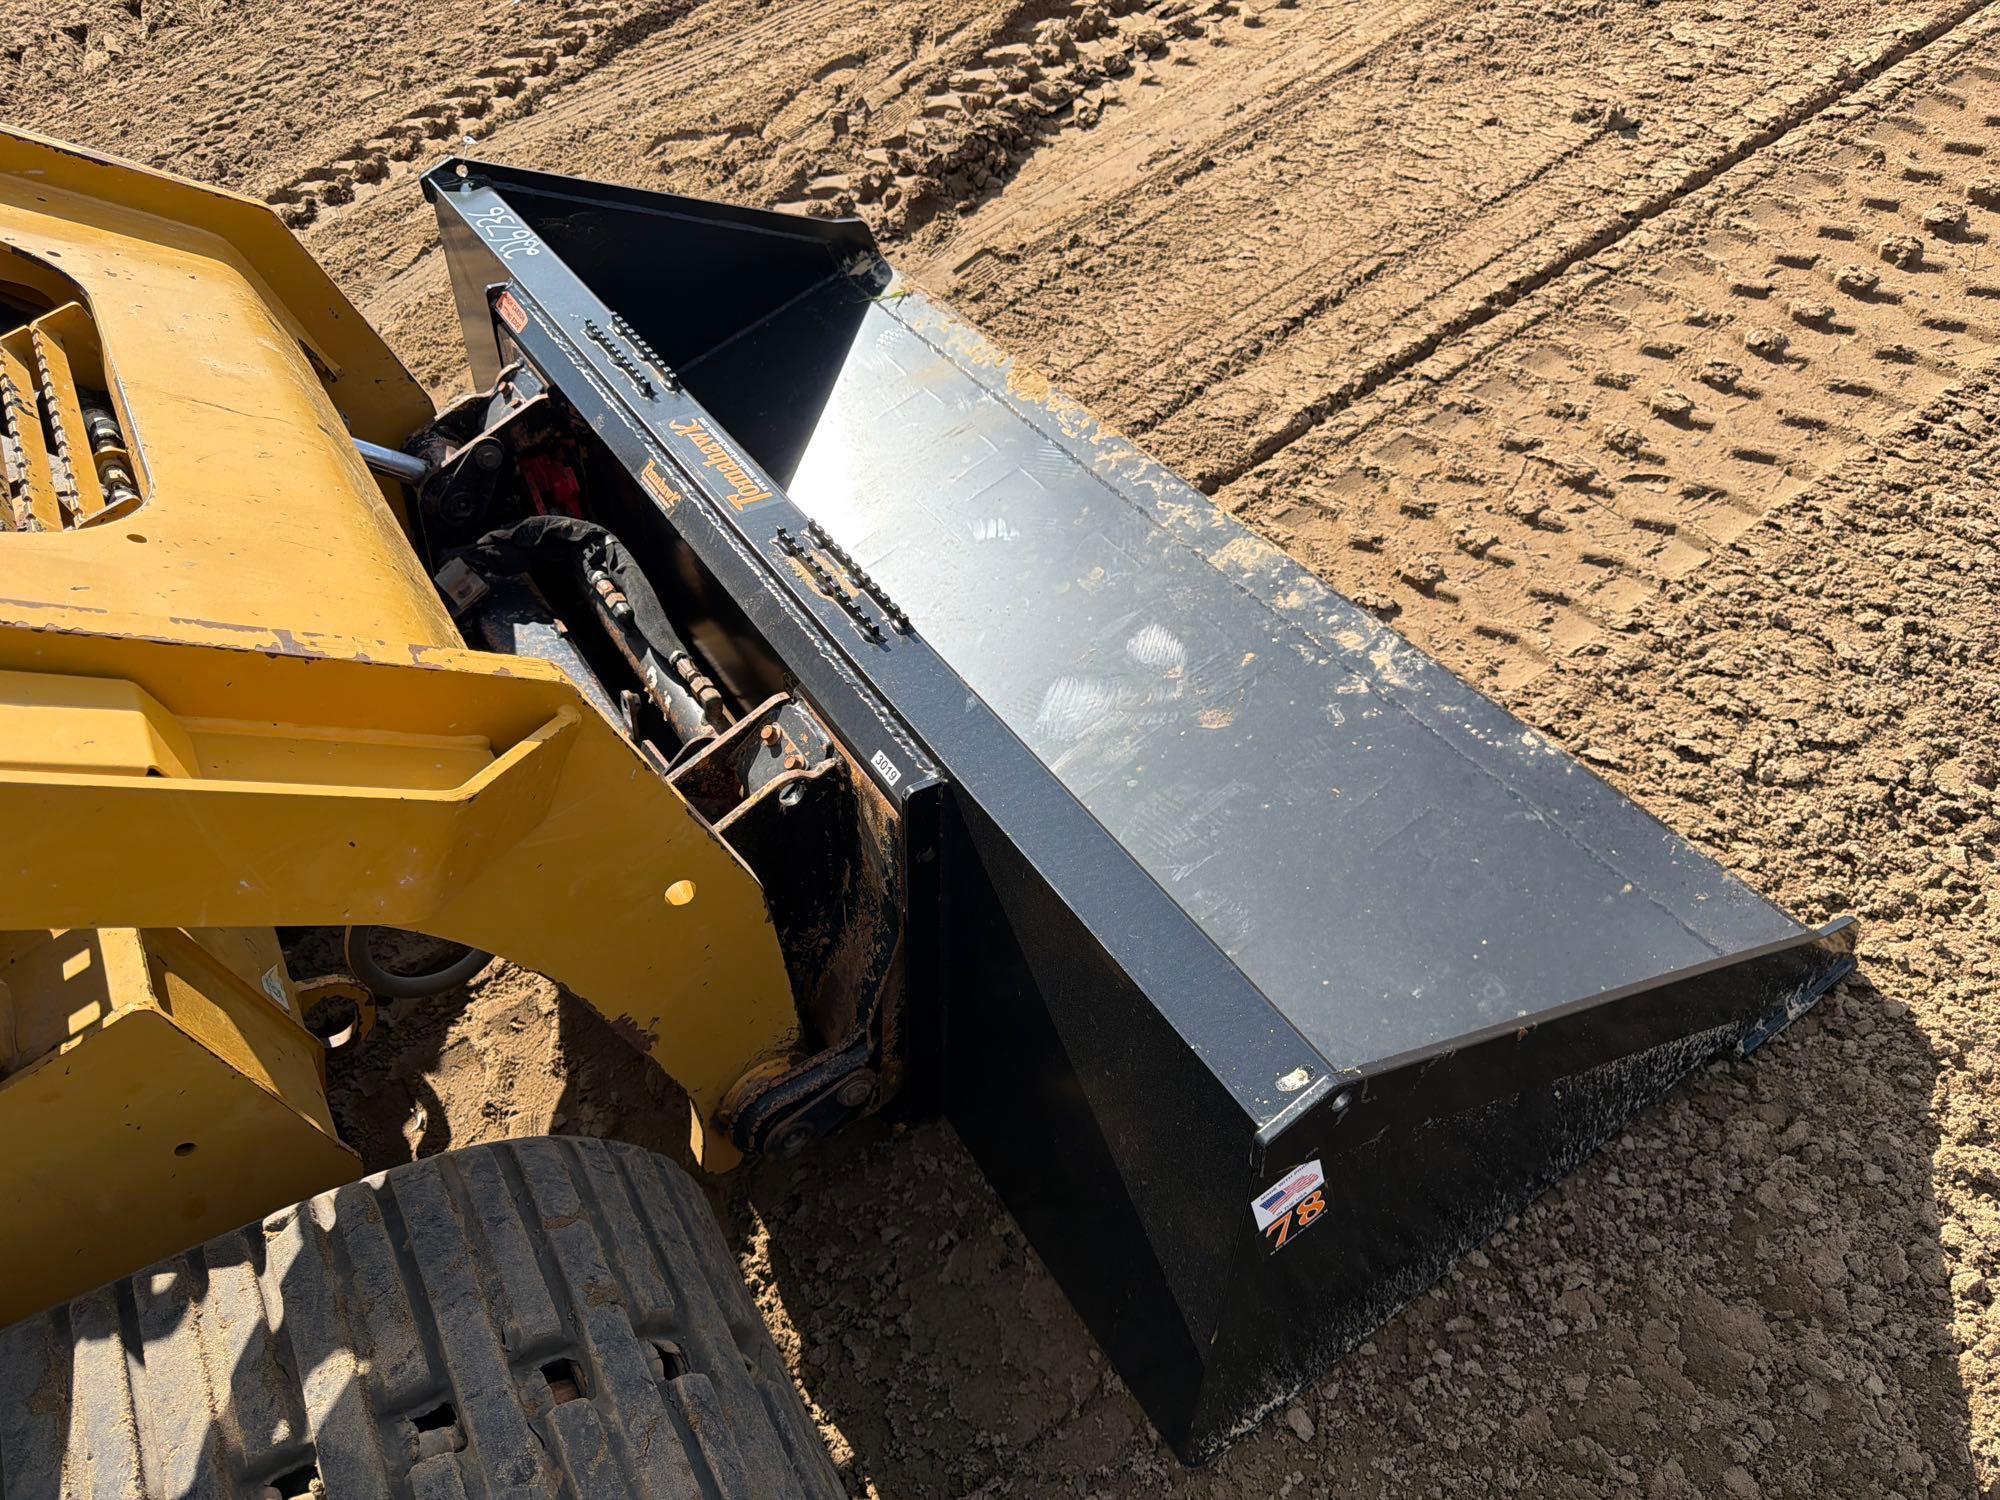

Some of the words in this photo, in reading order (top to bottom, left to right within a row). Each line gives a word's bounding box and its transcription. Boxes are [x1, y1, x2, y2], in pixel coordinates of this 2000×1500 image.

[641, 458, 682, 507] Tomahawk
[668, 417, 774, 512] Tomahawk
[875, 754, 898, 781] 3019
[1265, 1189, 1326, 1249] 78
